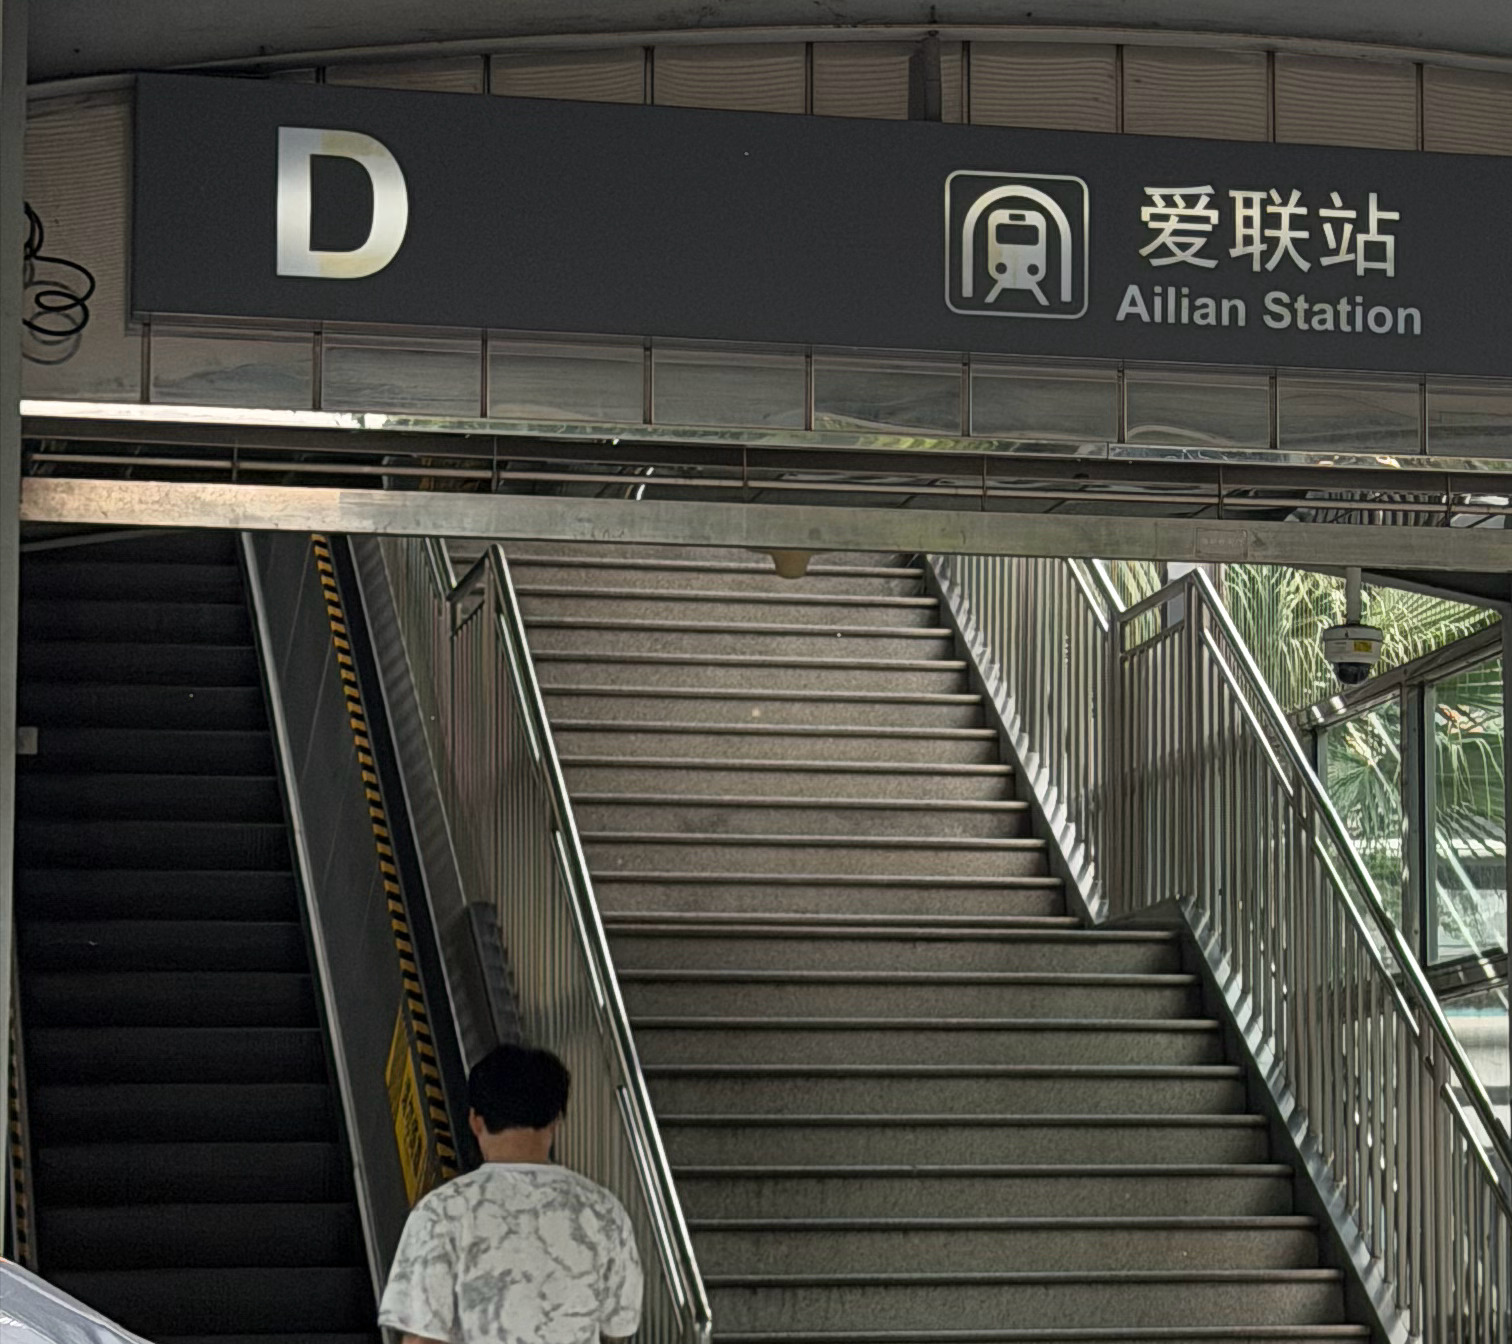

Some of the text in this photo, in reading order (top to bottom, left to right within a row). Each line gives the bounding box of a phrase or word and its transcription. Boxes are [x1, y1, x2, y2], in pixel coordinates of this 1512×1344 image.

[276, 125, 409, 280] D
[1138, 184, 1400, 278] 爱联站
[1115, 284, 1422, 335] Ailian Station
